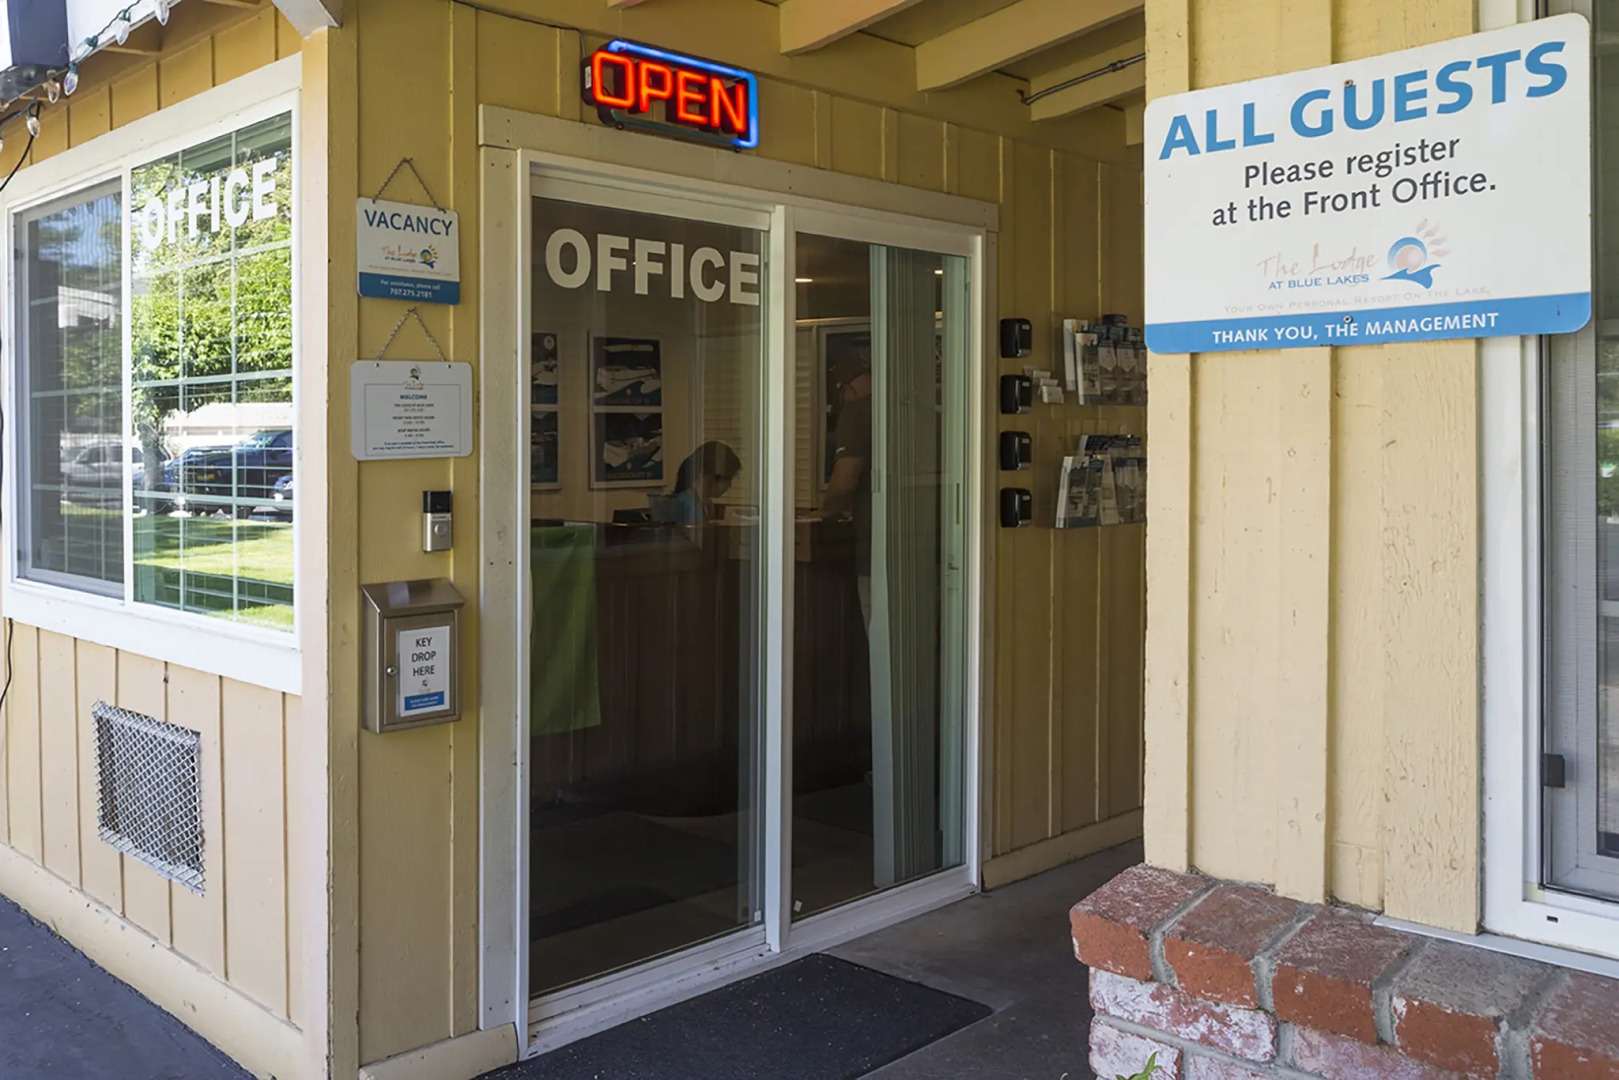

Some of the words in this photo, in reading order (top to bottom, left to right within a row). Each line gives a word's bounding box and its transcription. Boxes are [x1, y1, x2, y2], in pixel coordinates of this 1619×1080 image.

[592, 50, 747, 133] OPEN
[1158, 102, 1275, 160] ALL
[1289, 41, 1568, 139] GUESTS
[1244, 159, 1334, 188] Please
[1346, 138, 1461, 178] register
[141, 157, 278, 251] OFFICE
[1212, 202, 1237, 226] at
[1247, 196, 1291, 222] the
[1303, 183, 1381, 215] Front
[1391, 170, 1497, 204] Office.
[364, 208, 453, 236] VACANCY
[545, 228, 760, 306] OFFICE
[1256, 252, 1300, 277] The
[1308, 243, 1376, 285] Lodge
[1268, 281, 1283, 290] AT
[1287, 277, 1323, 289] BLUE
[1326, 273, 1370, 286] LAKES
[1212, 328, 1268, 344] THANK
[1273, 325, 1319, 341] YOU,
[1325, 323, 1358, 338] THE
[1365, 312, 1499, 336] MANAGEMENT
[411, 651, 437, 663] DROP
[415, 636, 433, 648] KEY
[412, 665, 436, 677] HERE
